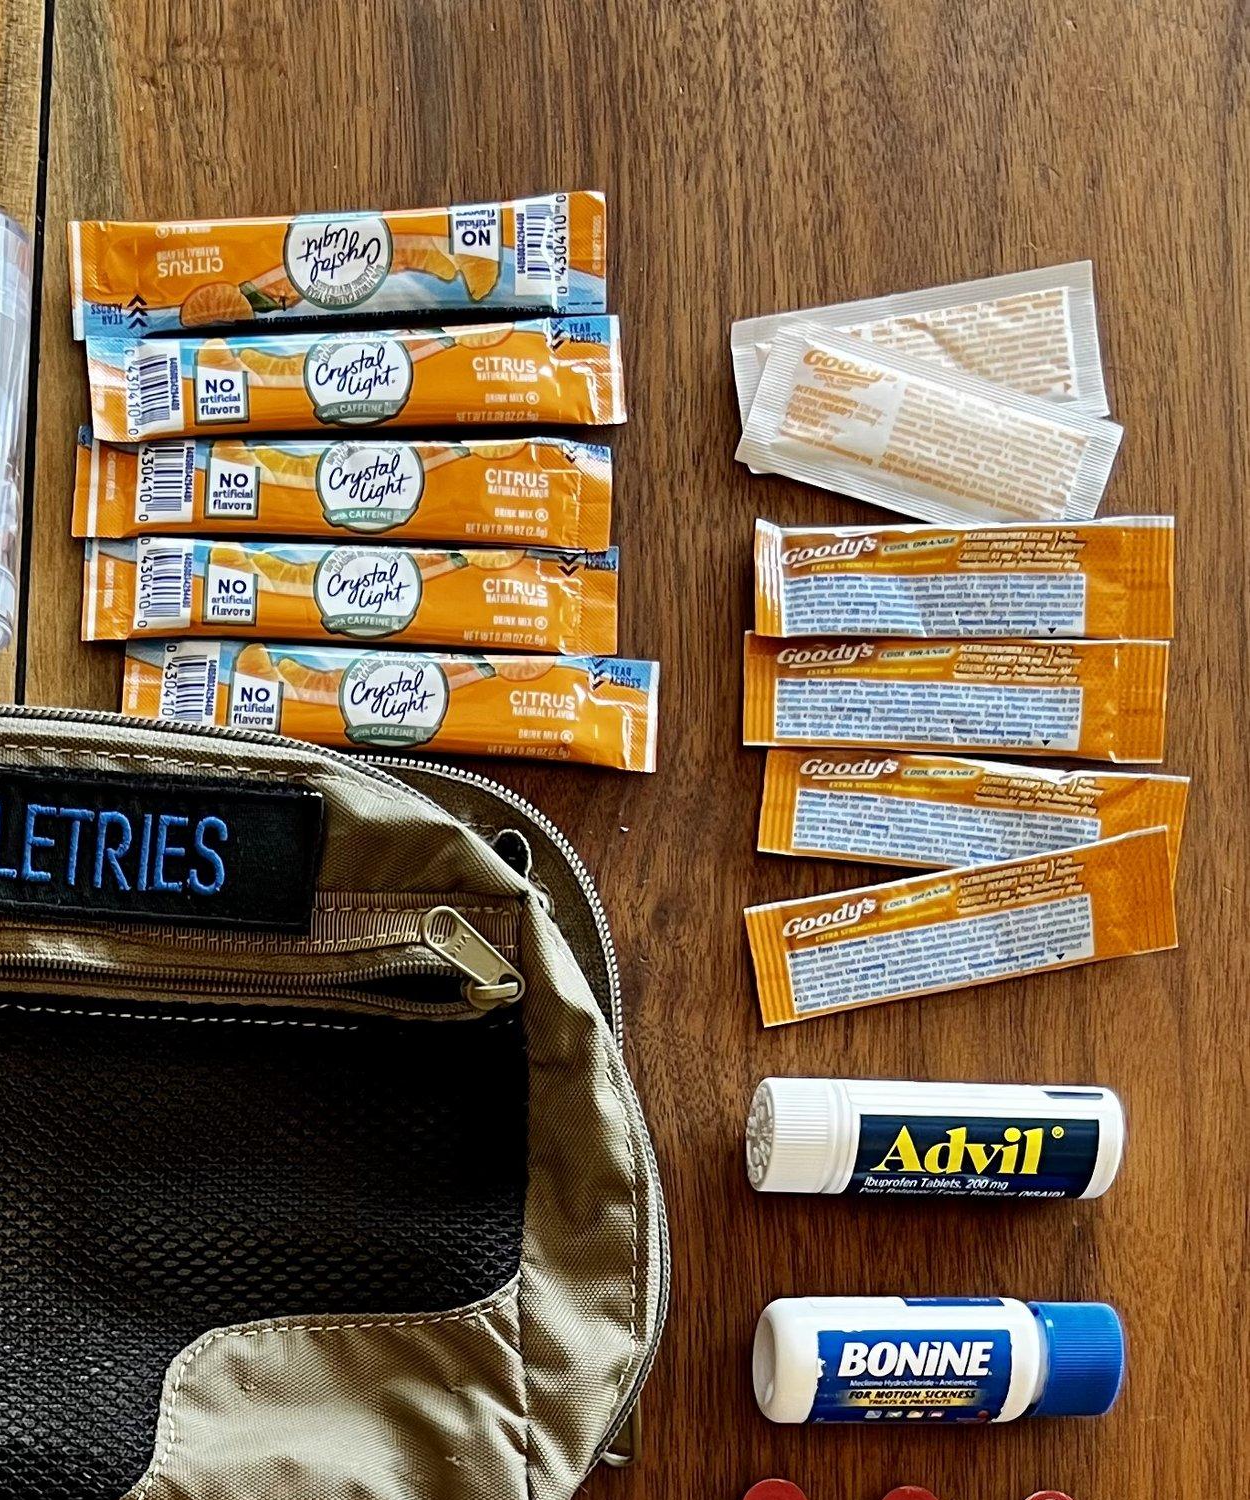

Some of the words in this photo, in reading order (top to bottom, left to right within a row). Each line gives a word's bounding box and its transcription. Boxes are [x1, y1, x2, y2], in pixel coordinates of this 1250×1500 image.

[461, 230, 491, 246] NO
[156, 257, 224, 278] CITRUS
[316, 346, 386, 391] Crystal
[471, 357, 537, 373] CITRUS
[206, 379, 235, 393] NO
[199, 393, 241, 404] artificial
[200, 404, 241, 416] flavors
[220, 473, 249, 488] NO
[328, 454, 401, 499] Crystal
[485, 469, 549, 488] CITRUS
[212, 488, 253, 499] artificial
[212, 499, 252, 511] flavors
[782, 536, 879, 568] Goody's
[218, 579, 247, 594] NO
[326, 562, 399, 605] Crystal
[482, 578, 548, 598] CITRUS
[777, 642, 875, 669] Goody's
[240, 687, 271, 701] NO
[350, 670, 425, 714] Crystal
[509, 690, 576, 710] CITRUS
[233, 702, 275, 713] artificial
[233, 712, 273, 726] flavors
[800, 758, 899, 781] Goody's
[782, 897, 878, 938] Goody's
[869, 1125, 1044, 1175] Advil
[863, 1177, 919, 1189] Ibuprofen
[966, 1178, 990, 1189] 200
[990, 1180, 1010, 1191] mg
[849, 1390, 873, 1400] FOR
[875, 1390, 922, 1400] MOTION
[924, 1390, 977, 1400] SICKNESS
